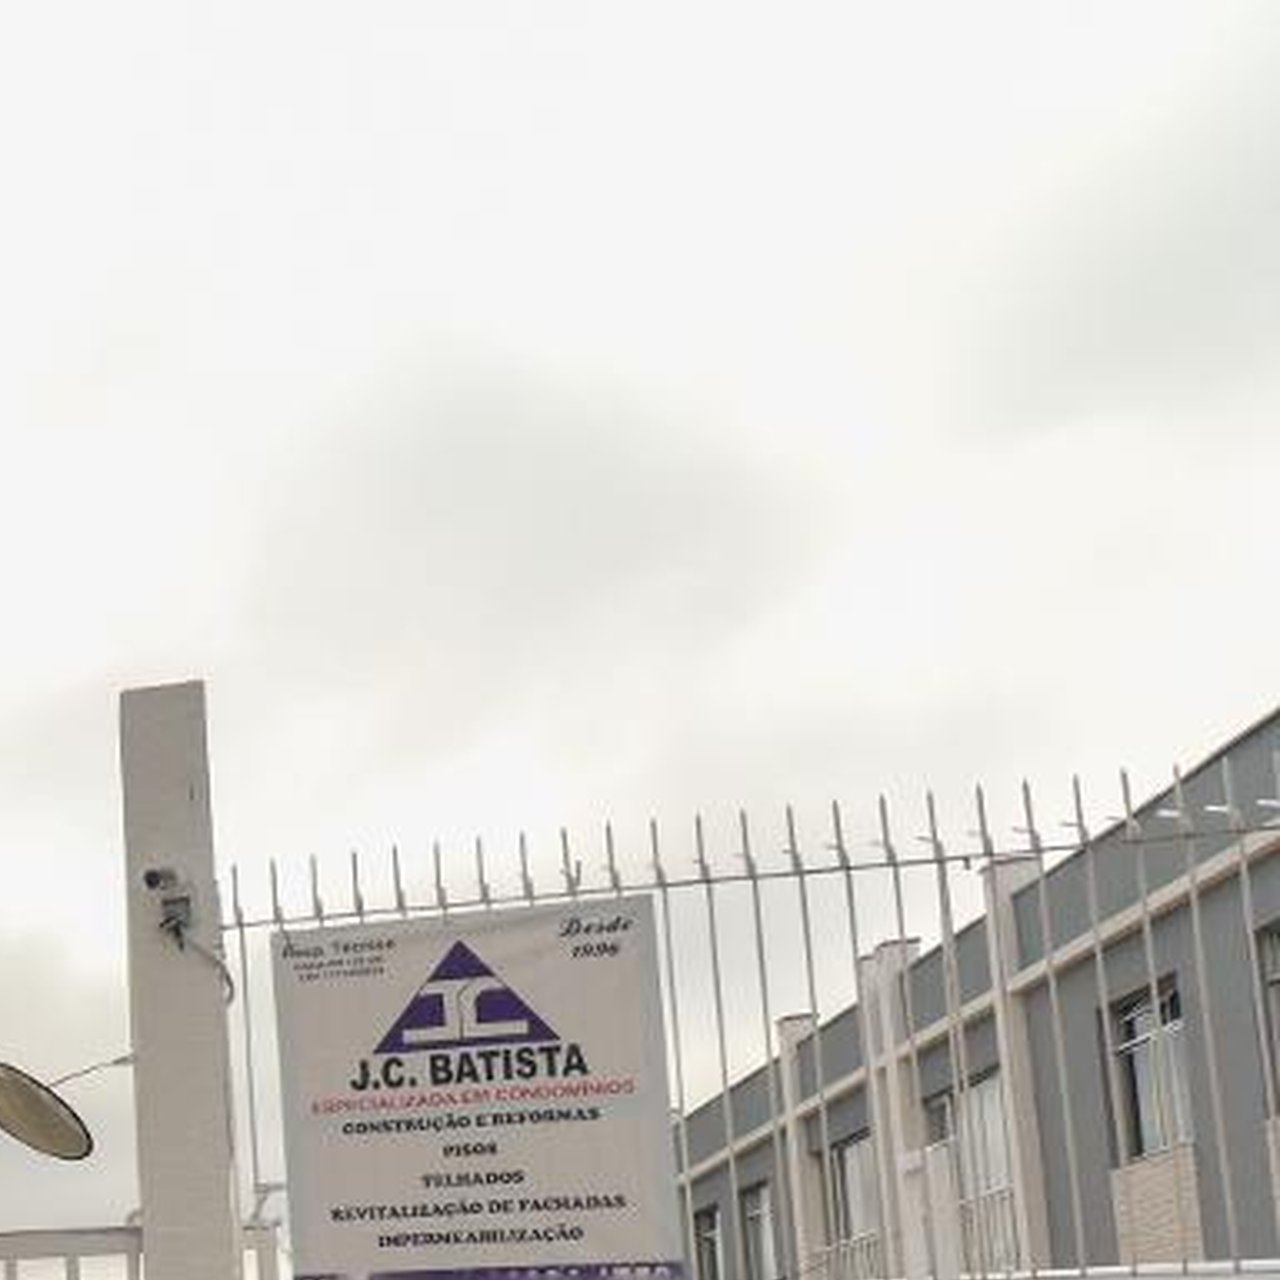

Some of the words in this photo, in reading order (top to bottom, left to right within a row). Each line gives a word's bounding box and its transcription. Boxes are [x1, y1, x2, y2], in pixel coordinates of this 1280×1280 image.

[559, 916, 634, 937] Desde
[350, 1057, 417, 1091] J.C.
[343, 1113, 471, 1135] CONSTRUÇÃO
[493, 1107, 601, 1126] REFORMAS
[443, 1142, 497, 1157] PISOS
[422, 1171, 525, 1188] TELHADOS
[489, 1199, 514, 1214] DE
[519, 1194, 627, 1212] FACHADAS
